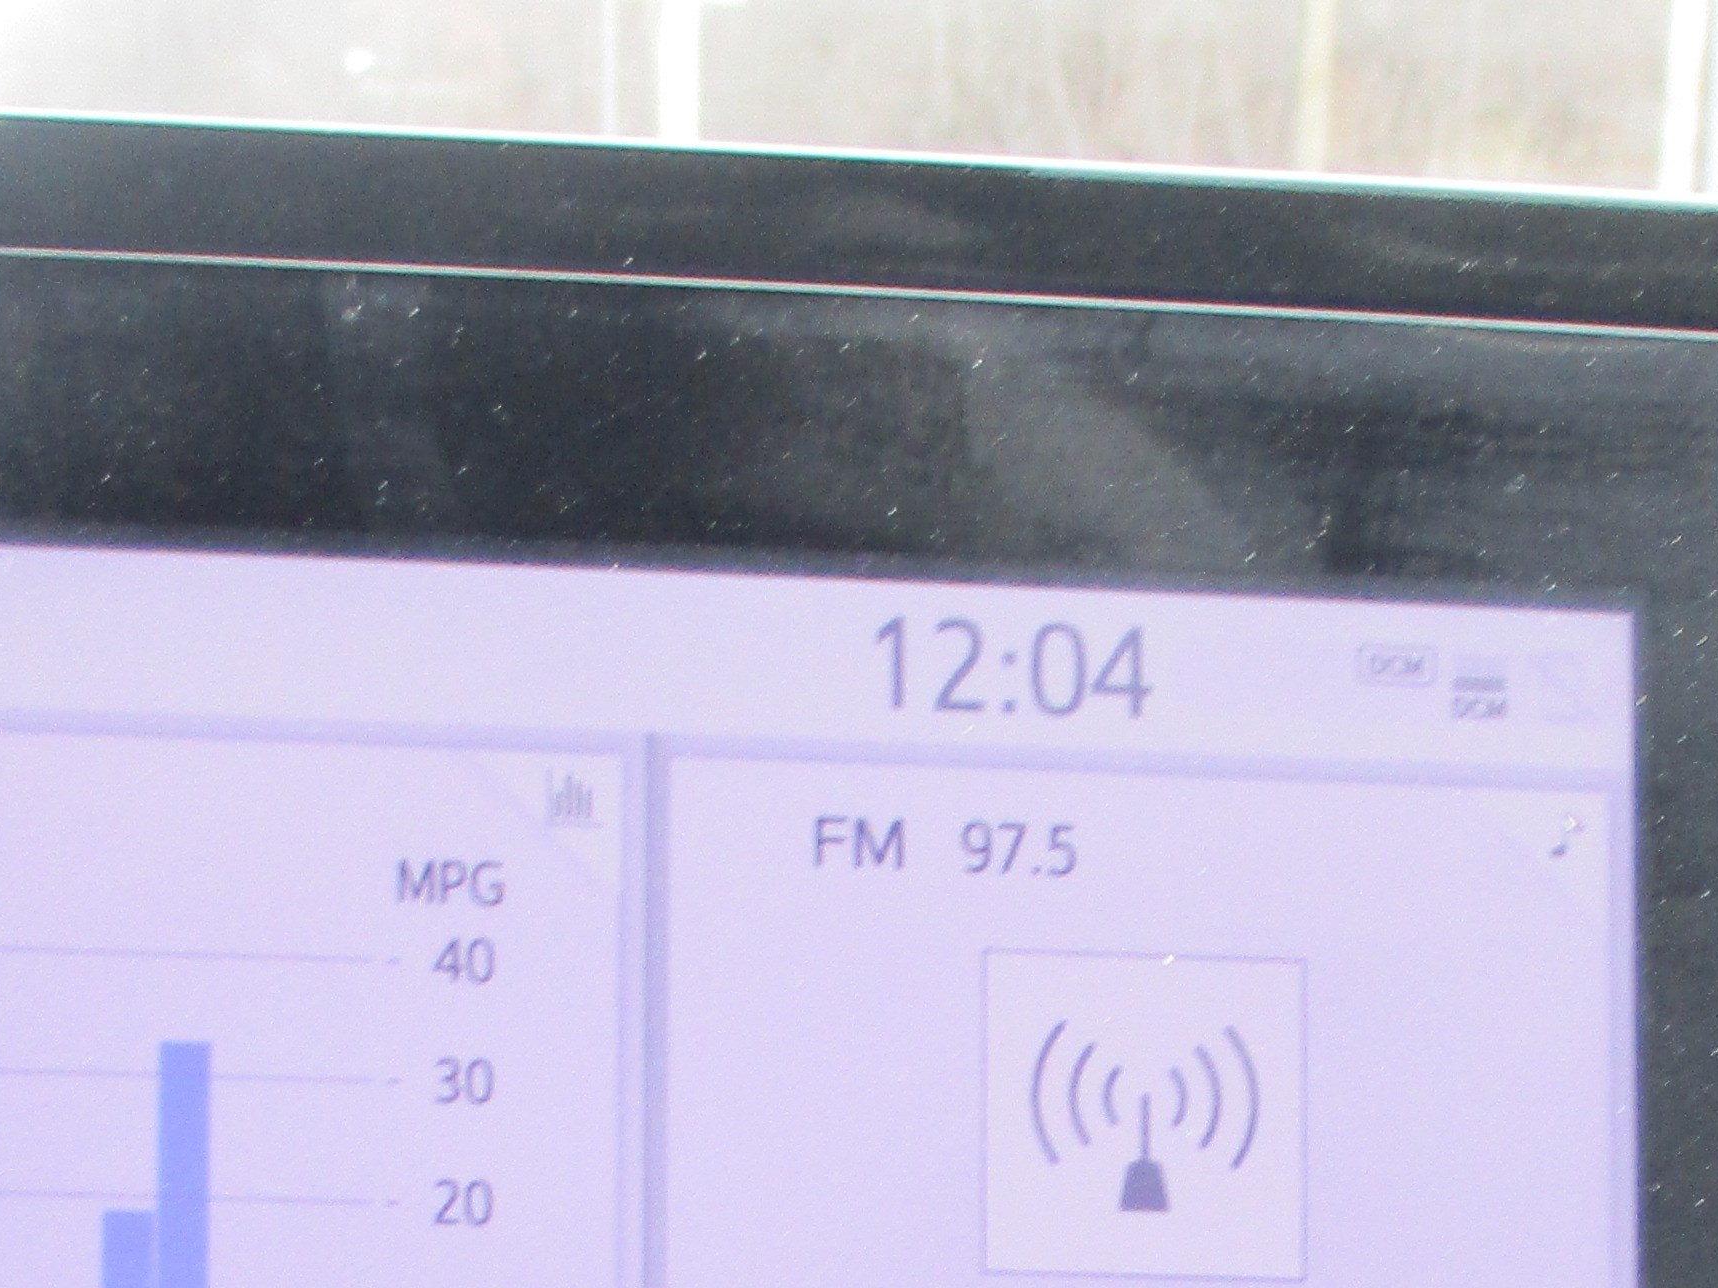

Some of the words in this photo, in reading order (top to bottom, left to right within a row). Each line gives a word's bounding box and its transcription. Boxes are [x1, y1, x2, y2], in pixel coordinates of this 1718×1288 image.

[875, 615, 1154, 719] 12:04
[812, 816, 905, 870] FM
[959, 820, 1079, 877] 97.5
[394, 857, 507, 908] MPG
[431, 935, 496, 984] 40
[433, 1056, 495, 1105] 30
[432, 1178, 494, 1227] 20
